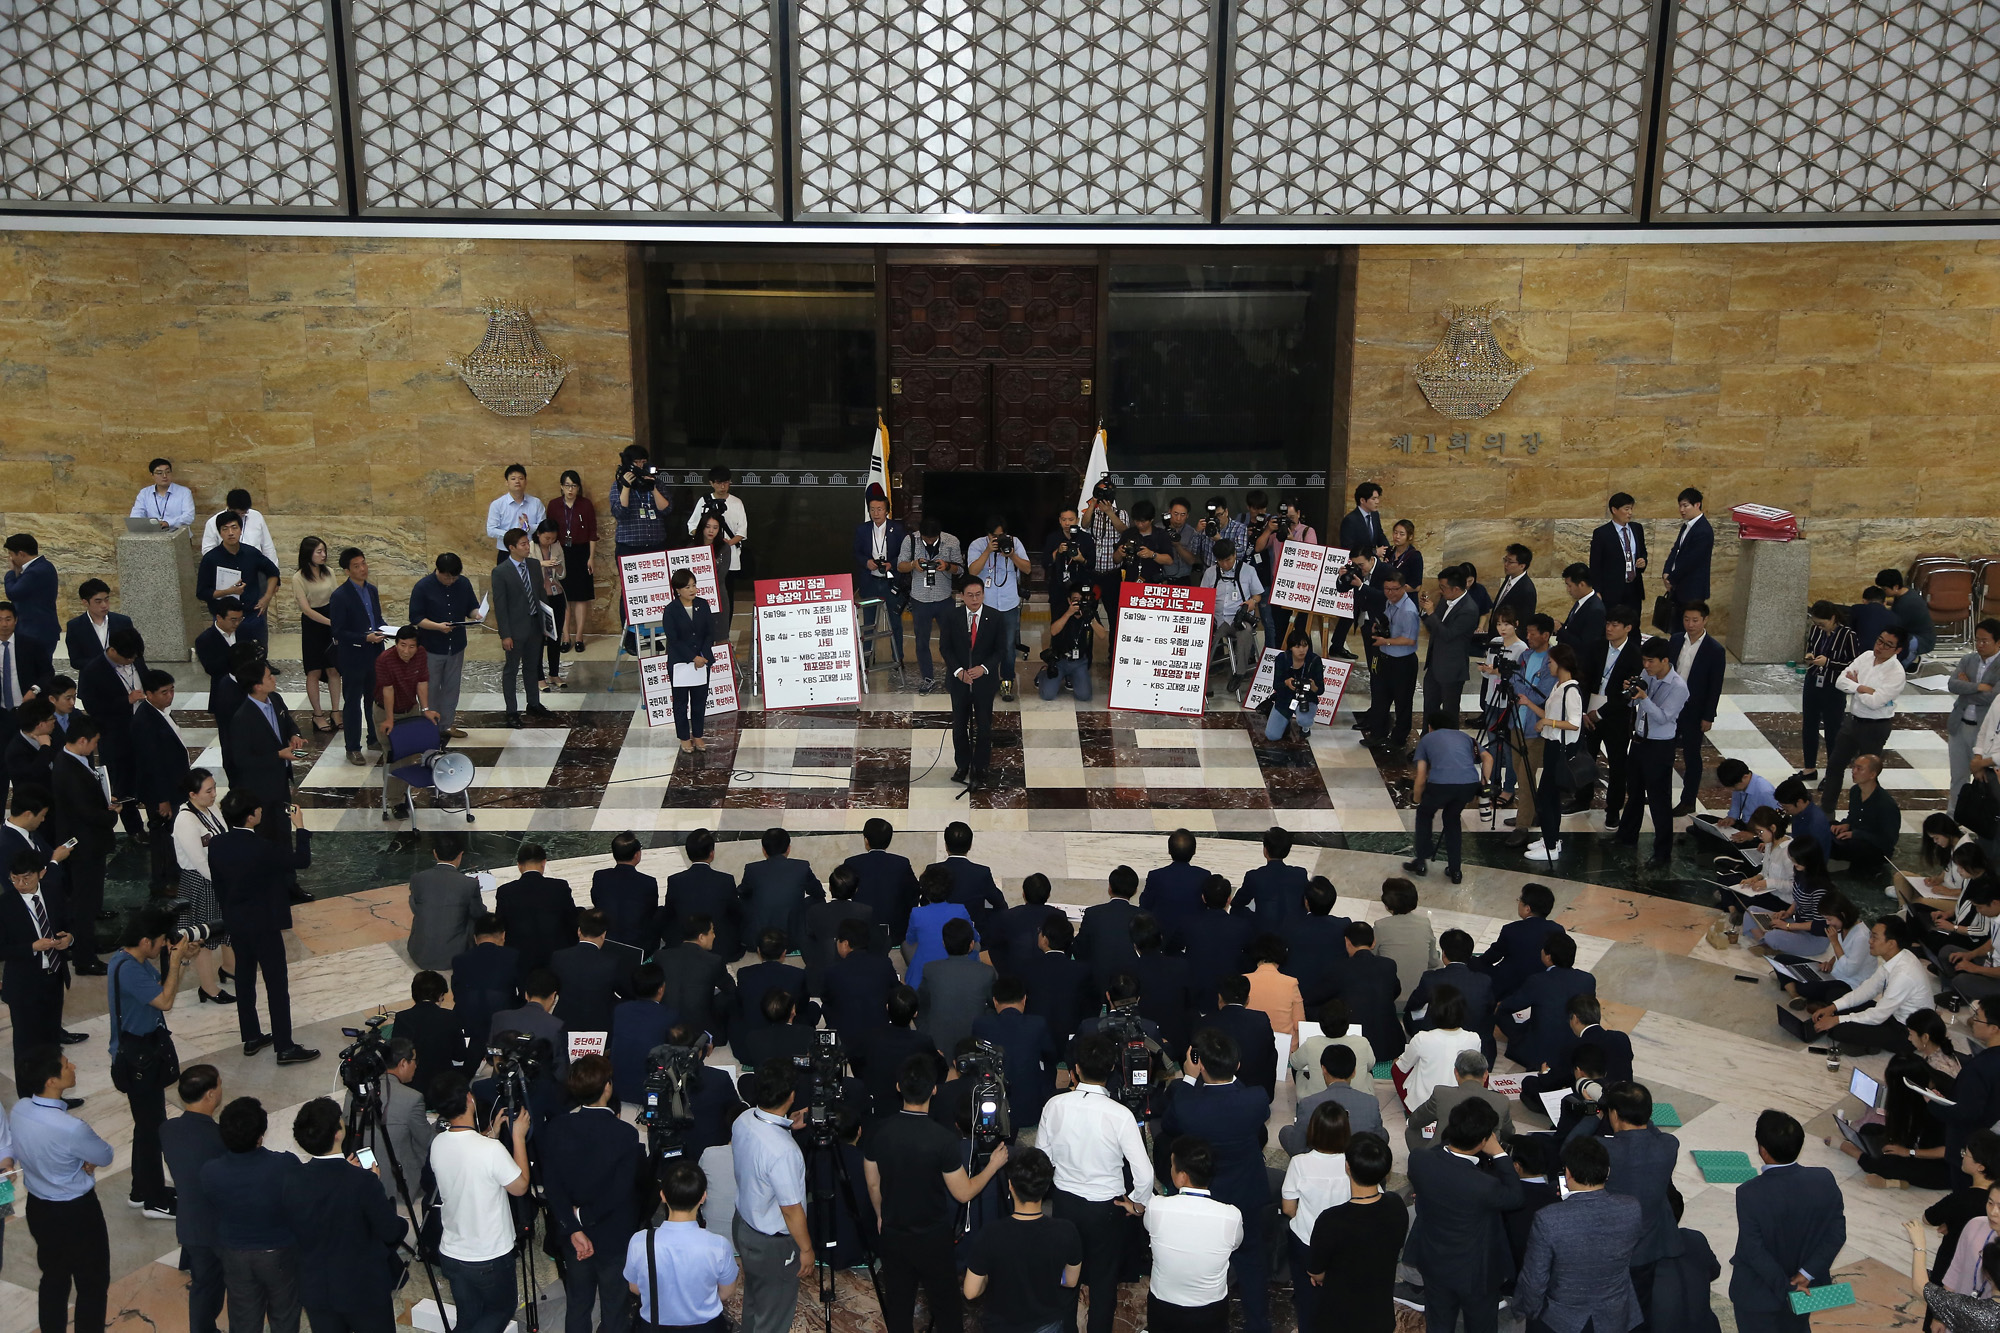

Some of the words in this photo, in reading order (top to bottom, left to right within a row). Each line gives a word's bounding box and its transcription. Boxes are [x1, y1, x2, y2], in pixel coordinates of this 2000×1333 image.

[1390, 432, 1545, 454] 제1회의장
[778, 580, 805, 591] 문재인
[807, 578, 826, 589] 정권
[766, 592, 802, 604] 방송장악
[804, 590, 822, 600] 시도
[824, 588, 842, 600] 규탄
[1144, 586, 1170, 597] 문재인
[1172, 588, 1190, 598] 정권
[834, 604, 847, 612] 사장
[1130, 596, 1164, 608] 방송장악
[1166, 599, 1184, 610] 시도
[1186, 600, 1204, 611] 규탄
[816, 615, 832, 624] 사퇴
[1193, 617, 1206, 626] 사장
[765, 634, 776, 642] 8월
[778, 632, 788, 640] 4일
[836, 627, 848, 636] 사장
[1174, 625, 1188, 634] 사퇴
[818, 638, 833, 648] 사퇴
[1121, 634, 1132, 642] 8월
[1190, 639, 1204, 648] 사장
[766, 656, 776, 664] 9월
[838, 650, 851, 658] 사장
[1171, 647, 1186, 656] 사퇴
[804, 660, 834, 671] 체포영장
[836, 660, 851, 670] 발부
[1119, 656, 1129, 664] 9월
[1190, 662, 1202, 670] 사장
[778, 678, 782, 686] ?
[819, 674, 838, 682] 고대영
[840, 672, 853, 681] 사장
[1153, 668, 1184, 679] 체포영장
[1184, 671, 1200, 680] 발부
[1126, 680, 1131, 688] ?
[1166, 682, 1186, 692] 고대영
[1186, 684, 1200, 692] 사장
[574, 1038, 602, 1046] 중단하고
